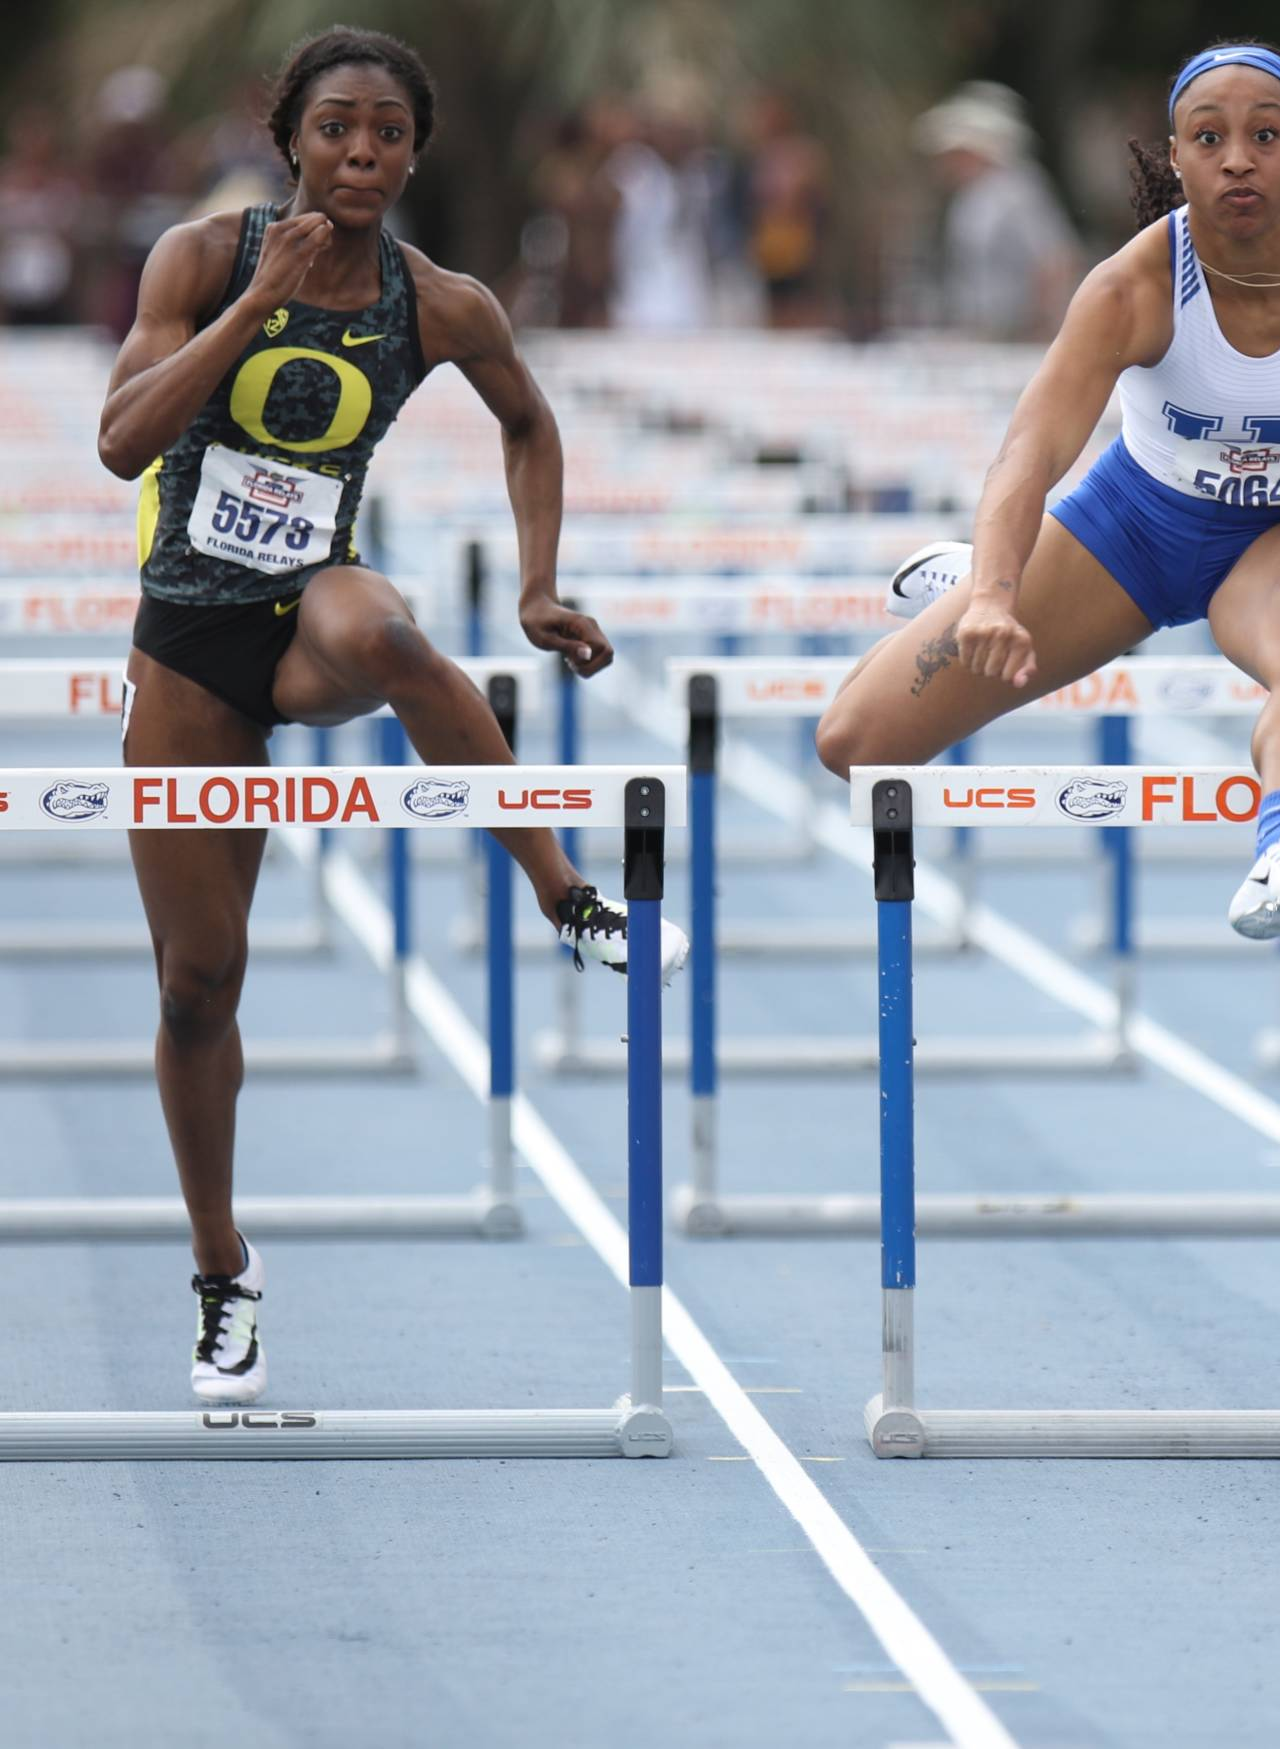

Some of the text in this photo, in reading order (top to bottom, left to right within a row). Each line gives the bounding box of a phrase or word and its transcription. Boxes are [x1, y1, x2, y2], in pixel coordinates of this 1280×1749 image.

[230, 346, 372, 453] O
[212, 490, 314, 551] 5573
[207, 537, 304, 568] FLORIDA RELAYS
[134, 776, 592, 823] FLORIDA UCS
[943, 787, 1037, 809] UCS
[203, 1412, 317, 1429] UCS
